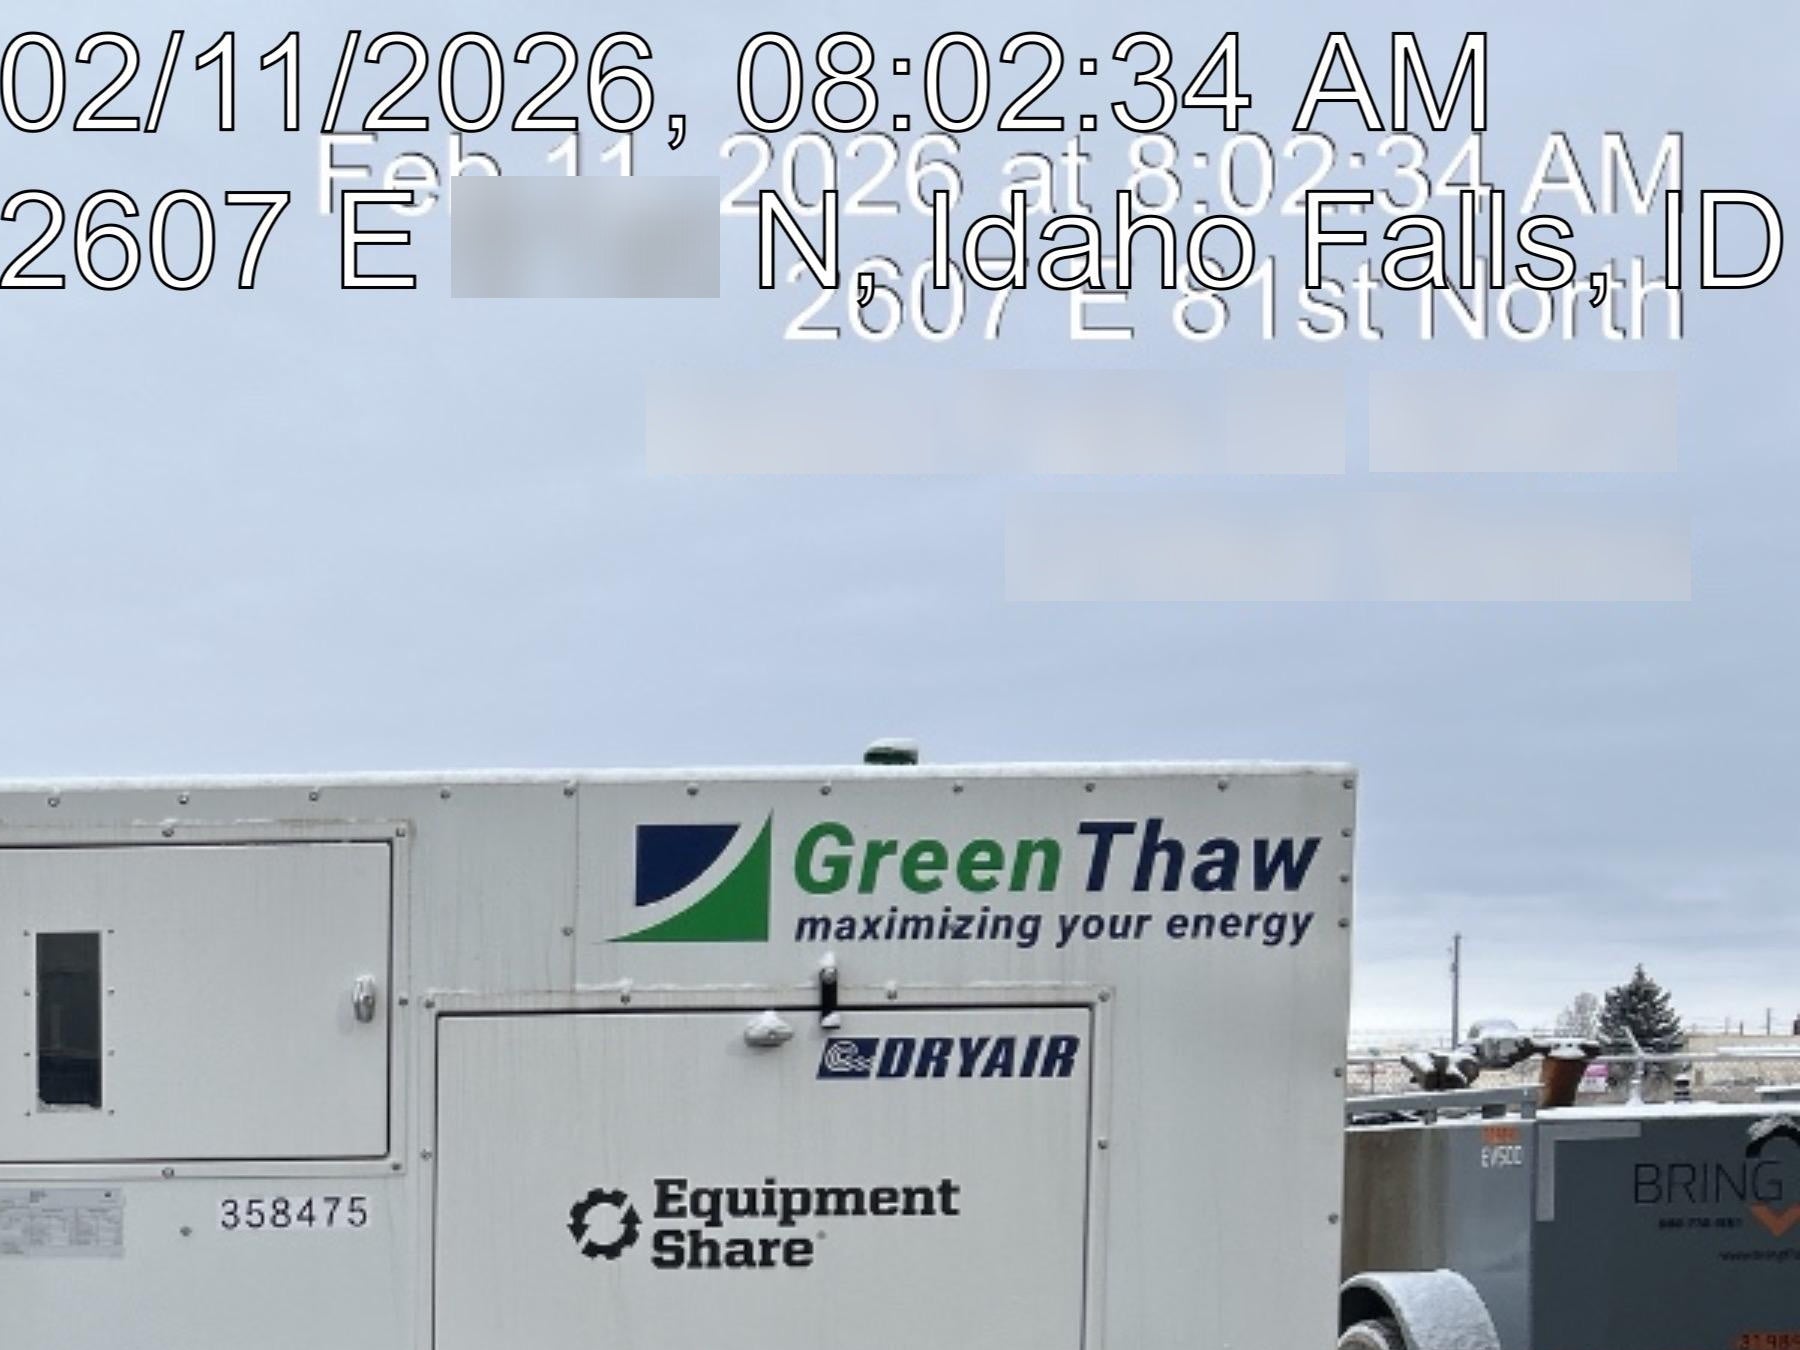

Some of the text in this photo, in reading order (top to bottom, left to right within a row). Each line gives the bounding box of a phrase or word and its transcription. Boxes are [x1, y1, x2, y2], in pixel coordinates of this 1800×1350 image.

[794, 905, 1316, 949] maximizing your energy
[875, 1034, 1081, 1079] DRYAIR
[652, 1177, 961, 1227] Equipment
[1633, 1160, 1784, 1204] BRING
[219, 1196, 370, 1230] 358475
[651, 1230, 815, 1270] Share
